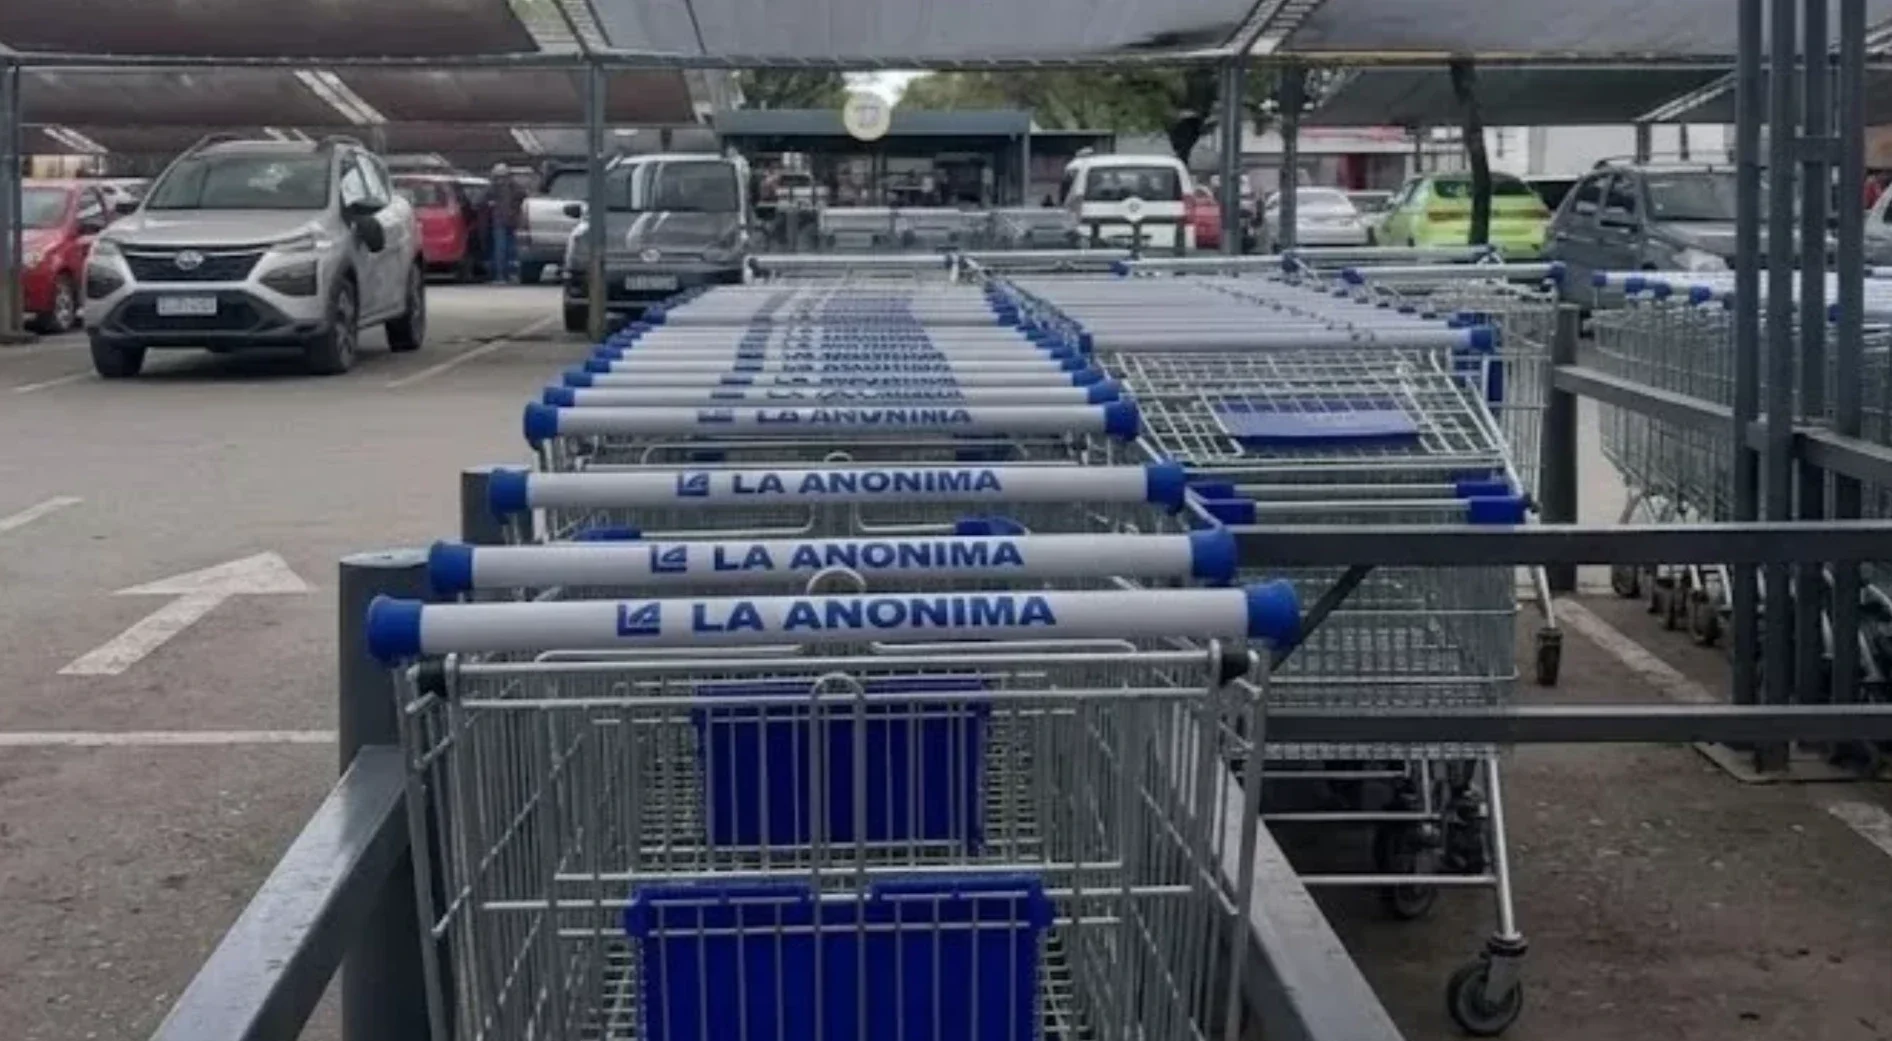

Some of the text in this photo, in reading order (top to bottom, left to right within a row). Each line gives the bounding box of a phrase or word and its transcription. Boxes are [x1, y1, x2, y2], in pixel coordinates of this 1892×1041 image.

[733, 470, 1002, 494] LA ANONIMA
[713, 541, 1024, 571] LA ANONIMA
[692, 596, 1057, 633] LA ANONIMA
